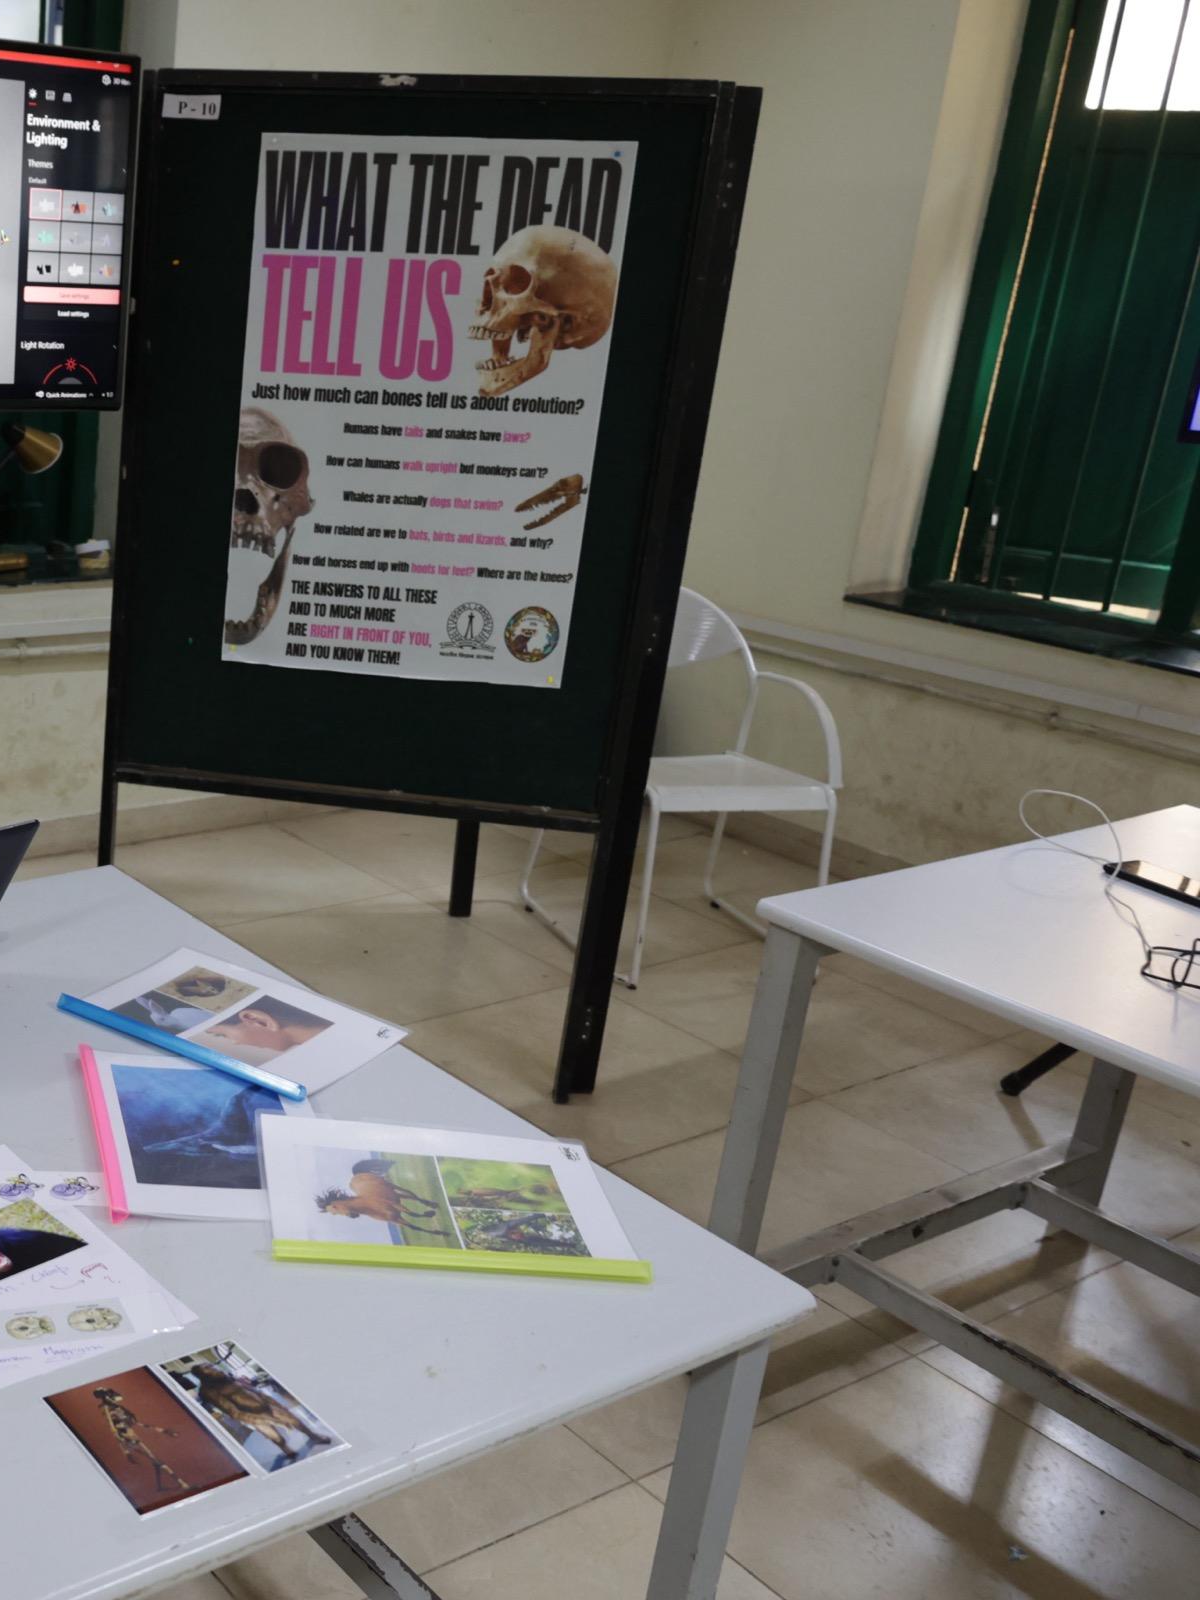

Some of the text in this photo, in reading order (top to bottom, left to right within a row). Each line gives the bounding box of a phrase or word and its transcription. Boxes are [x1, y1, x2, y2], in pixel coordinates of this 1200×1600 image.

[26, 113, 101, 132] Environment &
[26, 131, 68, 149] Lighting
[28, 158, 54, 169] Themes
[265, 150, 622, 256] WHAT THE DEAD
[260, 254, 461, 381] TELL US
[21, 341, 65, 350] Light Rotation
[252, 383, 584, 414] Just how much can bones tell us about evolution?
[344, 422, 378, 436] Humans
[381, 424, 402, 437] have
[426, 427, 443, 438] and
[445, 429, 477, 440] snakes
[480, 430, 501, 442] have
[503, 431, 531, 443] jaws?
[326, 455, 345, 468] How
[347, 457, 363, 468] can
[365, 458, 400, 470] humans
[403, 460, 423, 472] walk
[425, 462, 457, 474] upright
[459, 463, 474, 475] but
[476, 464, 518, 477] monkeys
[343, 491, 503, 511] Whales are actually dogs that swim?
[313, 522, 333, 534] How
[334, 524, 365, 537] related
[367, 527, 381, 538] are
[383, 528, 397, 539] we
[398, 529, 407, 540] to
[432, 531, 456, 543] birds
[457, 532, 474, 544] and
[510, 535, 527, 547] and
[529, 538, 554, 550] why?
[292, 553, 310, 566] How
[312, 555, 326, 567] did
[327, 557, 358, 569] horses
[359, 558, 375, 570] end
[377, 560, 388, 573] up
[390, 560, 409, 572] with
[437, 563, 450, 575] for
[452, 564, 475, 577] feet?
[477, 565, 504, 579] Where
[506, 568, 521, 580] are
[523, 568, 538, 581] the
[539, 570, 574, 584] knees?
[291, 580, 438, 604] THE ANSWERS TO ALL THESE
[289, 601, 396, 622] AND TO MUCH MORE
[287, 622, 308, 637] ARE
[310, 623, 340, 639] RIGHT
[343, 626, 353, 640] IN
[357, 627, 390, 643] FRONT
[392, 630, 406, 644] OF
[409, 632, 432, 648] YOU,
[286, 642, 400, 665] AND YOU KNOW THEM!
